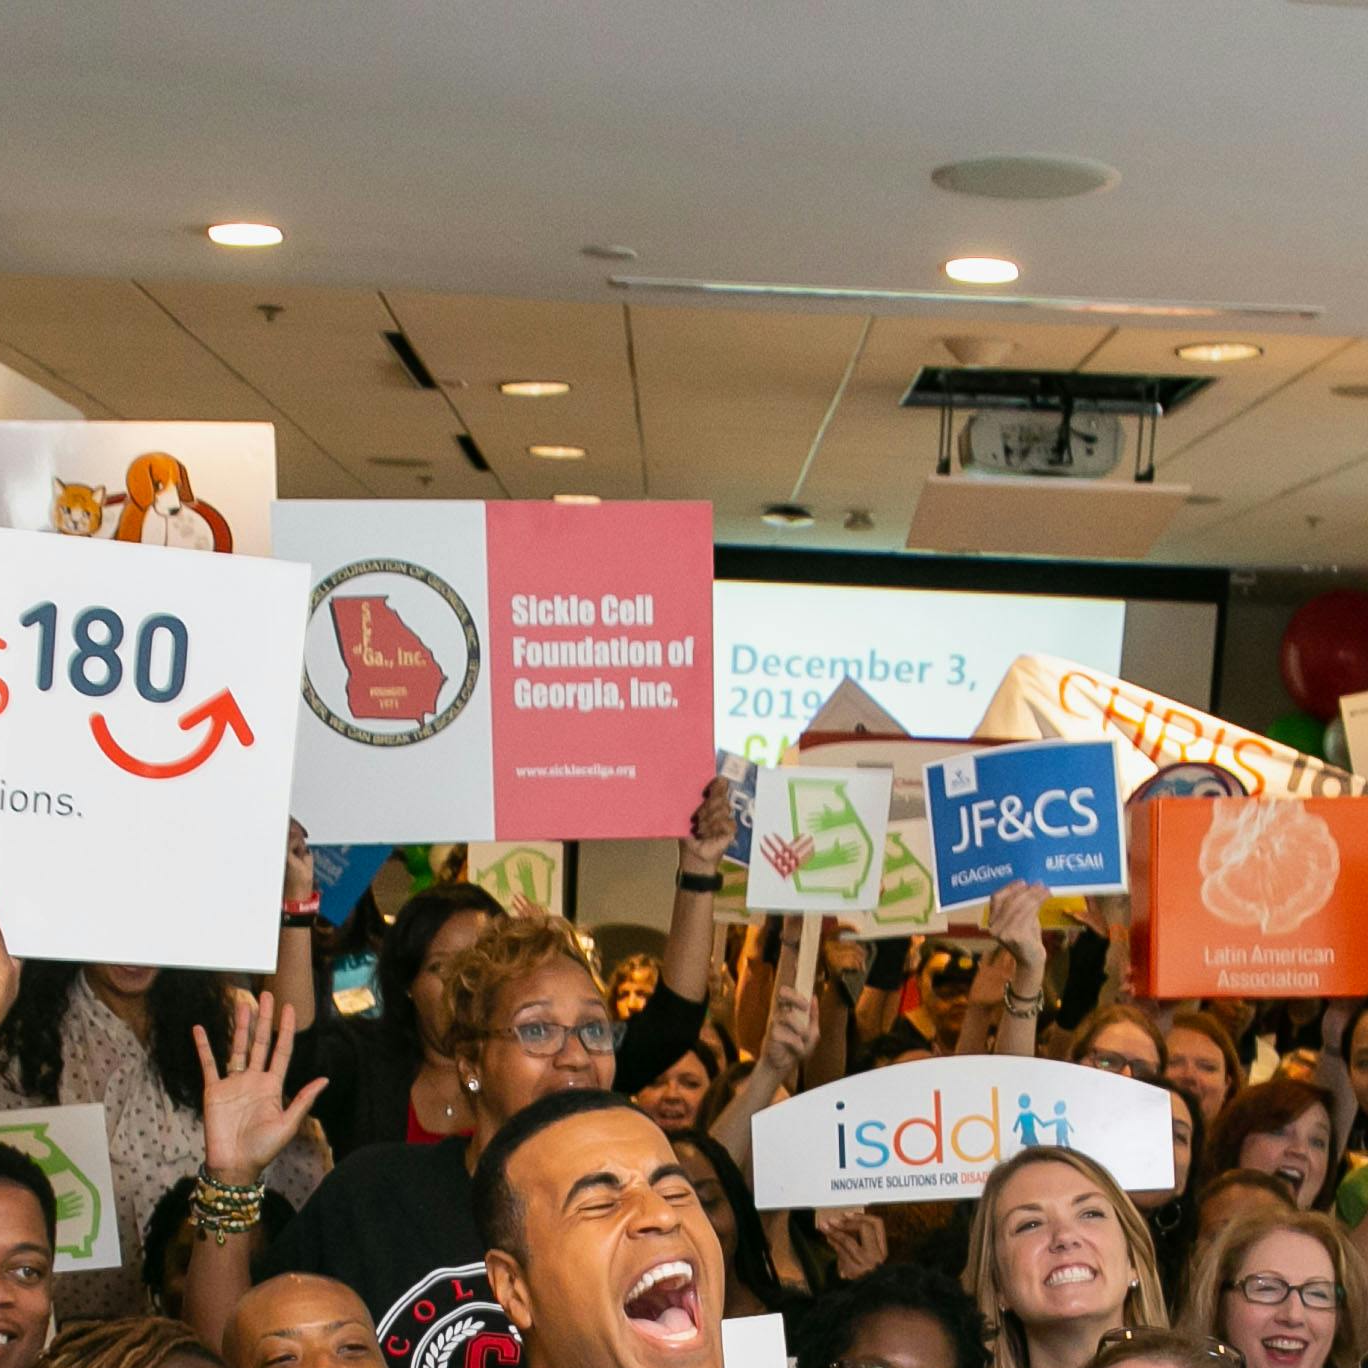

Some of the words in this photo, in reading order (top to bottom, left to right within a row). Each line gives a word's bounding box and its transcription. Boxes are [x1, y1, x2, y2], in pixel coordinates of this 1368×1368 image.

[511, 593, 596, 627] Sickle
[600, 593, 654, 626] Cell
[398, 646, 427, 667] Inc.
[512, 635, 663, 668] Foundation
[667, 635, 695, 667] of
[730, 644, 934, 686] December
[946, 654, 978, 692] 3,
[514, 676, 624, 713] Georgia,
[629, 676, 679, 708] Inc.
[1057, 671, 1275, 797] CHRIS
[951, 786, 1101, 855] JF&CS
[951, 862, 1014, 887] #GAGives
[1204, 945, 1248, 965] Latin
[1251, 945, 1335, 966] American
[1217, 970, 1320, 989] Association
[835, 1086, 1001, 1170] isdd
[831, 1174, 884, 1192] INNOVATIVE
[886, 1173, 938, 1189] SOLUTIONS
[940, 1172, 959, 1186] FOR
